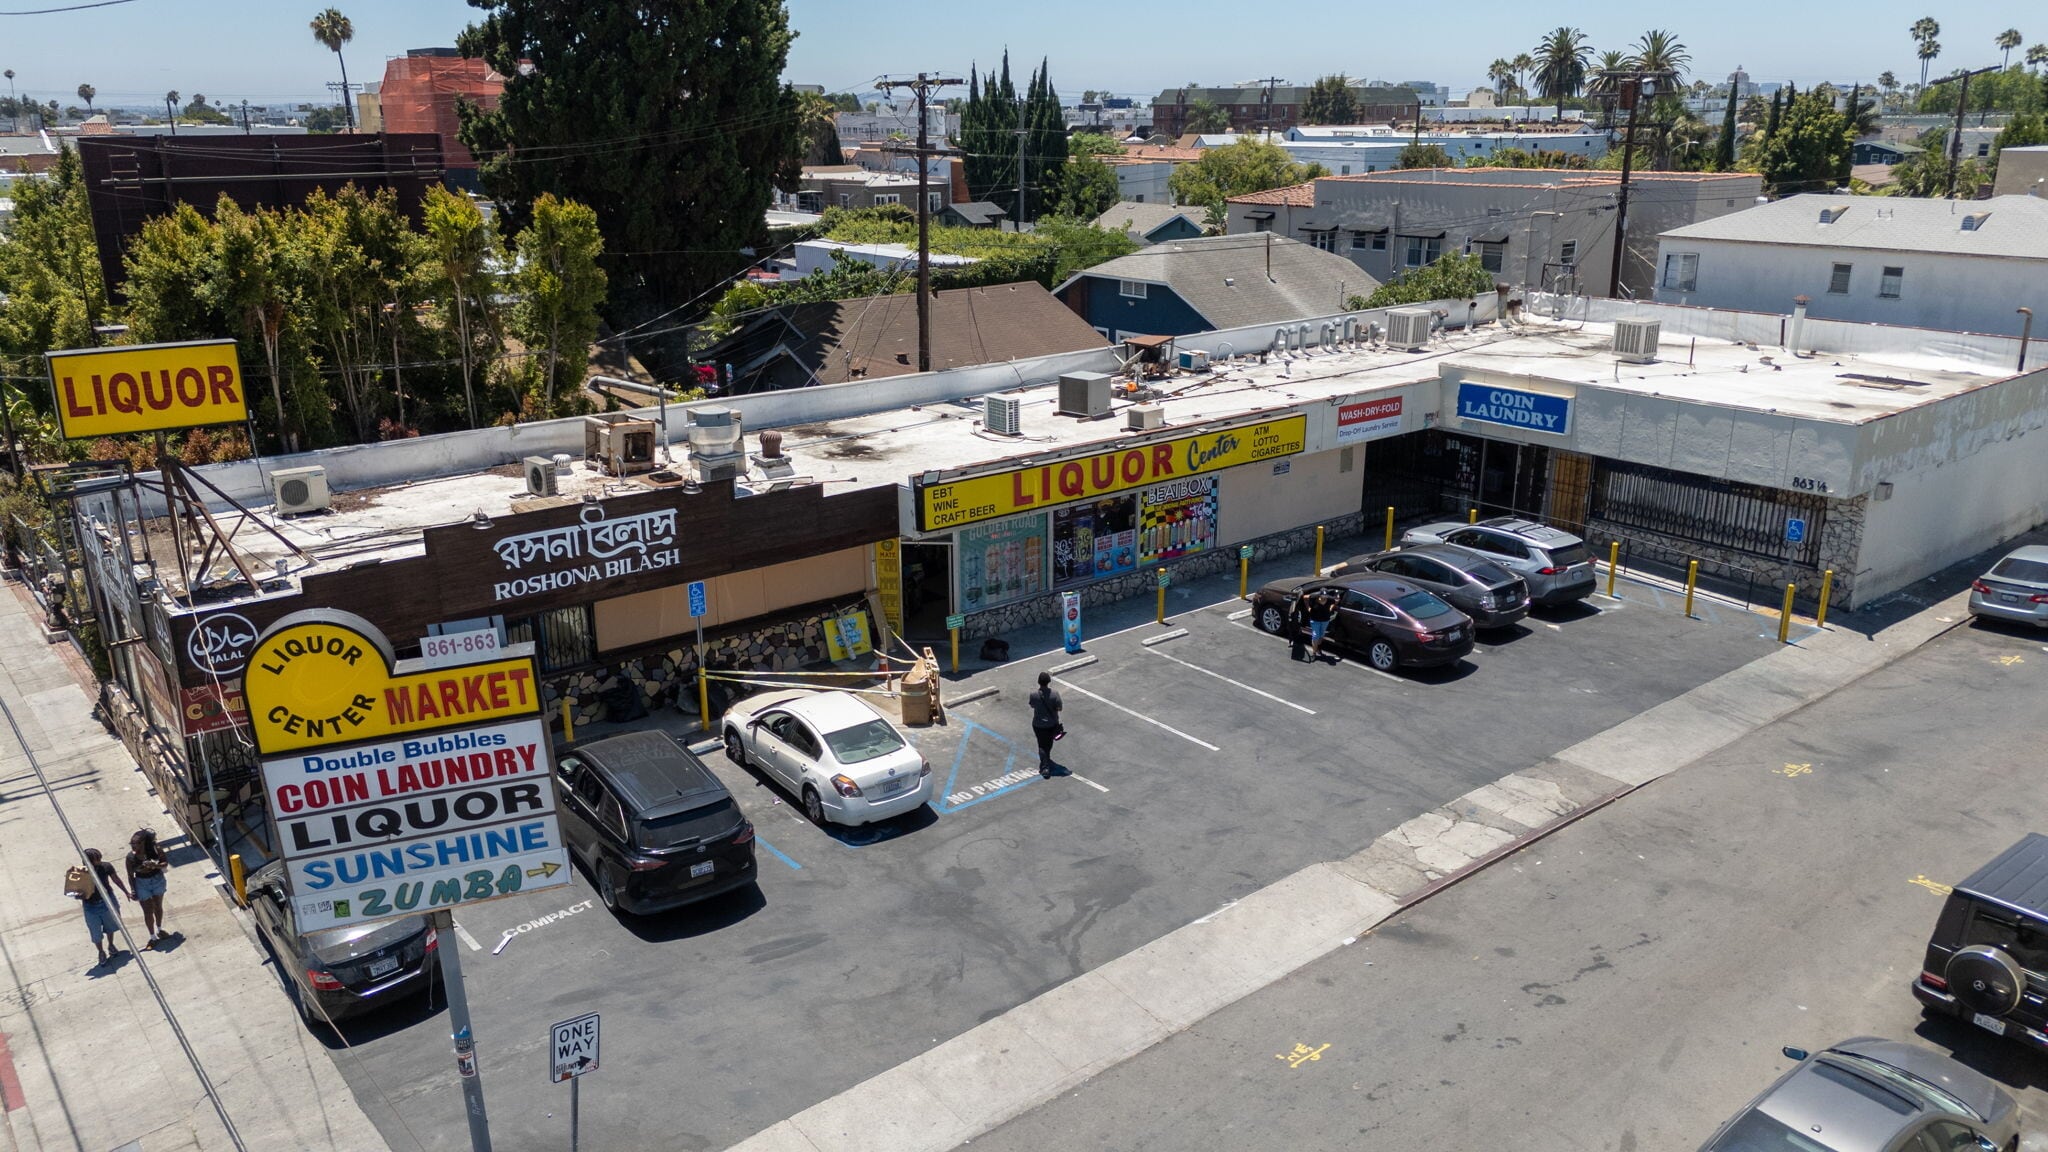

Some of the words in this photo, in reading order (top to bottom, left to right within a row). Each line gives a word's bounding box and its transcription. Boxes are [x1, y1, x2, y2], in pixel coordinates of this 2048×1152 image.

[63, 365, 239, 417] LIQUOR
[1490, 391, 1535, 410] COIN
[1341, 402, 1400, 420] WASH-DRY-FOLD
[1465, 401, 1558, 428] LAUNDRY
[1253, 434, 1279, 446] LOTTO
[1254, 426, 1269, 436] ATM
[1339, 426, 1361, 437] Drop-Off
[1362, 423, 1381, 434] Laundry
[1381, 420, 1399, 430] Service
[1251, 441, 1300, 458] CIGARETTES
[1013, 444, 1173, 507] LIQUOR
[1187, 434, 1240, 471] Center
[1792, 477, 1814, 490] 863
[933, 487, 954, 500] EBT
[933, 499, 959, 512] WINE
[1148, 477, 1210, 506] BEATBOX
[933, 510, 967, 525] CRAFT
[970, 504, 995, 517] BEER
[493, 525, 580, 570] রসনা
[580, 507, 678, 558] বিলাস
[494, 564, 602, 600] ROSHONA
[605, 548, 680, 578] BILASH
[193, 626, 253, 656] حلال
[427, 633, 495, 657] 861-863
[209, 651, 245, 664] HALAL
[261, 636, 363, 676] LIQUOR
[384, 668, 529, 725] MARKET
[268, 694, 376, 738] CENTER
[303, 749, 396, 774] Double
[403, 732, 506, 759] Bubbles
[276, 772, 369, 813] COIN
[377, 744, 536, 796] LAUNDRY
[946, 791, 974, 805] NO
[970, 767, 1040, 796] PARKING
[291, 783, 544, 851] LIQUOR
[303, 822, 549, 890] SUNSHINE
[359, 864, 522, 916] ZUMBA
[502, 900, 593, 938] COMPACT
[559, 1021, 594, 1043] ONE
[558, 1036, 594, 1059] WAY
